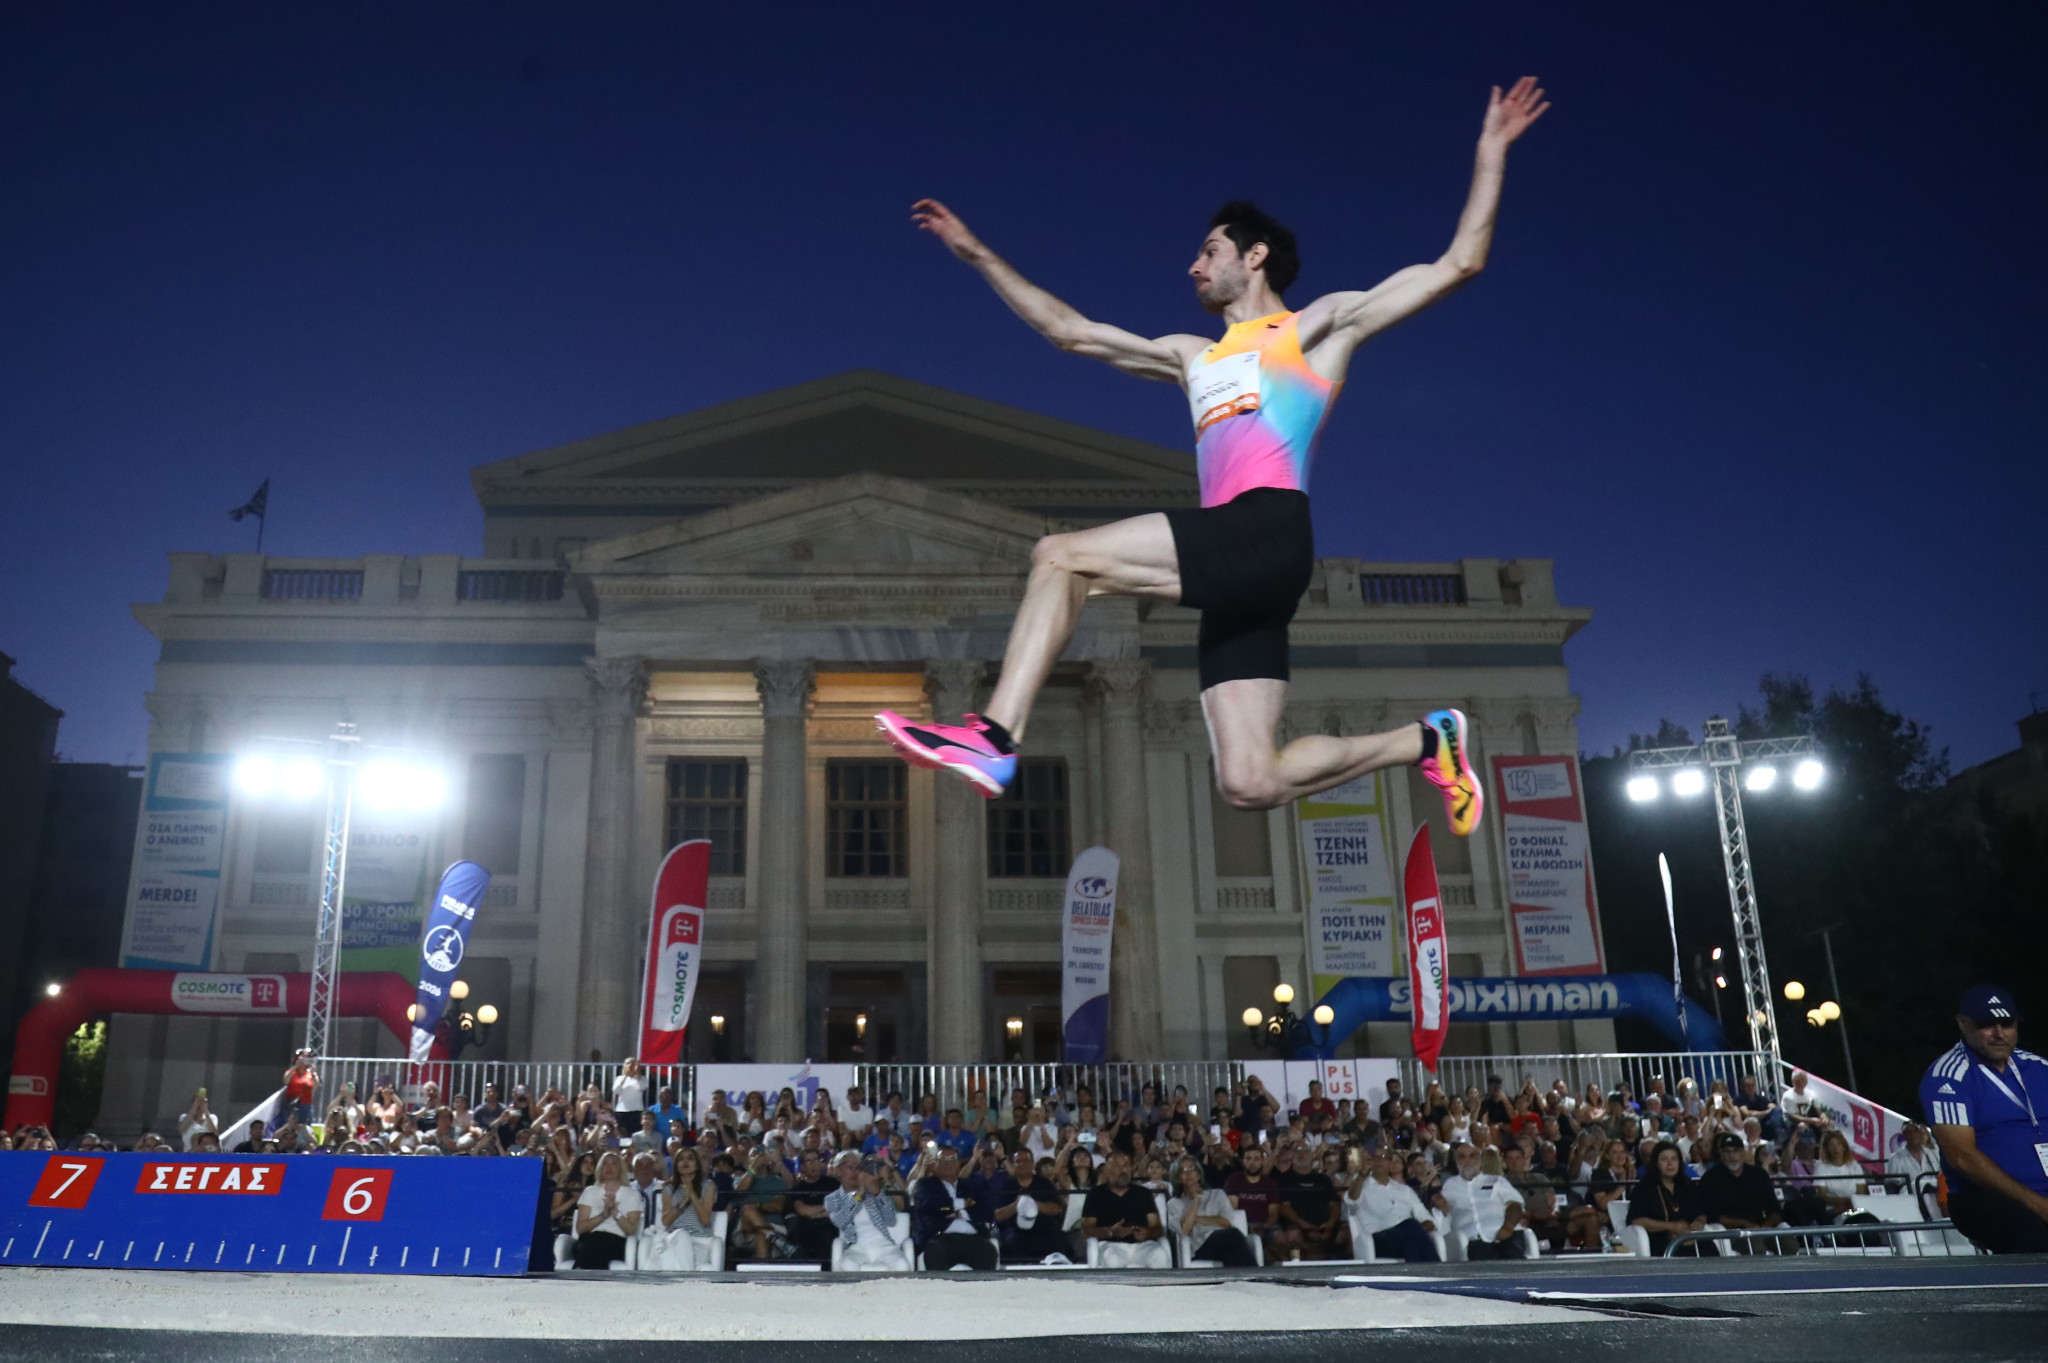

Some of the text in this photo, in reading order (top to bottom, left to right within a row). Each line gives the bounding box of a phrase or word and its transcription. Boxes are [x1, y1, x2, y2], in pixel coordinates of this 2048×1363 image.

[1315, 836, 1367, 850] ΤΖΕΝΗ
[1509, 835, 1568, 846] Ο ΦΟΝΙΑΣ,
[1316, 851, 1368, 865] ΤΖΕΝΗ
[1510, 848, 1562, 858] ΕΓΚΛΗΜΑ
[1512, 860, 1582, 870] ΚΑΙ ΑΘΩΩΣΗ
[140, 887, 197, 902] MERDE!
[1072, 901, 1112, 918] DELATOLAS
[1322, 915, 1385, 927] ΠΟΤΕ ΤΗΝ
[1323, 930, 1382, 942] ΚΥΡΙΑΚΗ
[1525, 925, 1570, 935] ΜΕΡΙΛΙΝ
[178, 981, 245, 994] COSMOTE
[49, 1163, 87, 1200] 7
[150, 1166, 270, 1191] ΣΕΓΑΣ
[342, 1177, 375, 1215] 6
